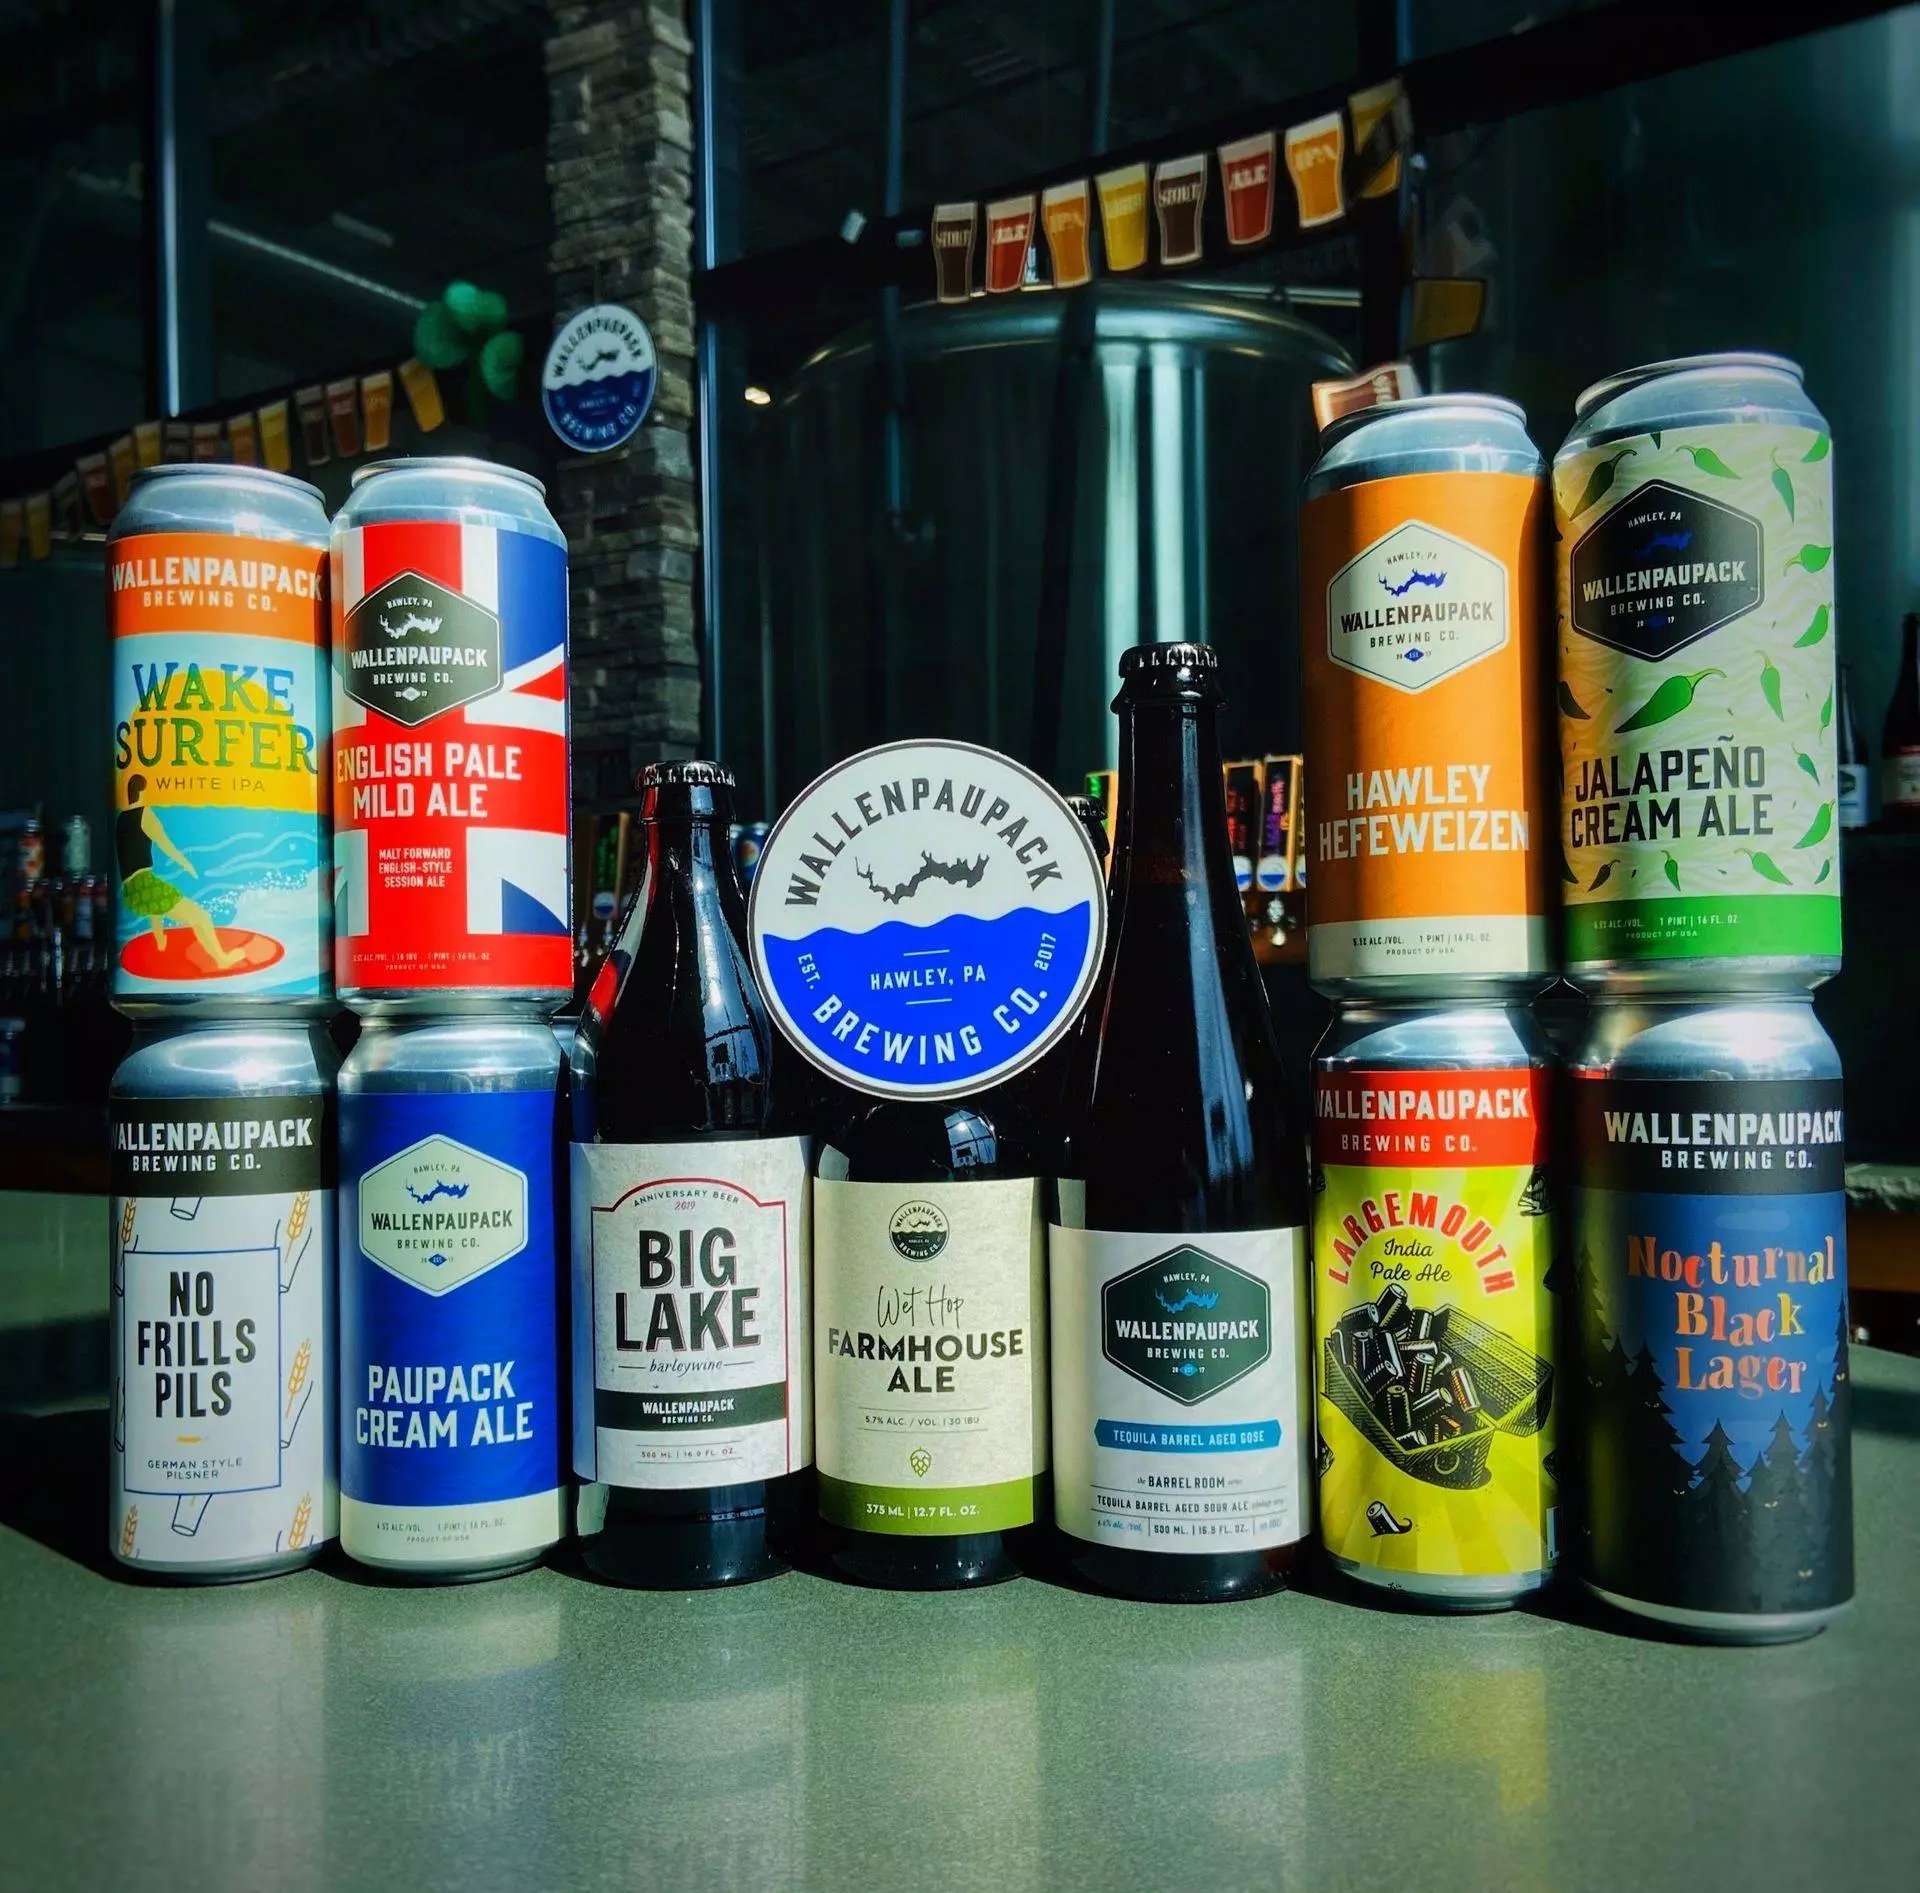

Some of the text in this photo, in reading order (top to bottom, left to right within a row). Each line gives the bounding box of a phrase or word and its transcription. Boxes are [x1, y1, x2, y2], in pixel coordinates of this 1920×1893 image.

[1229, 164, 1268, 192] ALE
[1628, 511, 1681, 528] HAWLEY, PA
[1387, 552, 1437, 565] HAWLEY, PA
[112, 557, 322, 602] WALLENPAUPACK
[1582, 561, 1746, 602] WALLENPAUPACK
[143, 590, 277, 612] BREWING CO.
[1610, 593, 1705, 616] BREWING CO.
[1341, 602, 1493, 634] WALLENPAUPACK
[1370, 631, 1460, 648] BREWING CO.
[351, 646, 488, 669] WALLENPAUPACK
[132, 662, 295, 717] WAKE
[373, 673, 453, 685] BREWING CO.
[116, 719, 319, 775] SURFER
[337, 743, 522, 782] ENGLISH PALE
[1574, 735, 1765, 802] JALAPEÑO
[156, 776, 266, 794] WHITE IPA
[1347, 765, 1491, 812] HAWLEY
[353, 782, 488, 819] MILD ALE
[1570, 794, 1774, 849] CREAM ALE
[784, 778, 1062, 906] WALLENPAUPACK
[1319, 811, 1529, 862] HEFEWEIZEN
[380, 848, 452, 860] MALT FORWARD
[379, 861, 452, 874] ENGLISH-STYLE
[384, 876, 445, 888] SESSION ALE
[1668, 917, 1687, 926] PINT
[1034, 932, 1057, 971] 2017
[798, 952, 820, 990] EST.
[870, 964, 986, 990] HAWLEY, PA
[812, 986, 1048, 1065] BREWING CO.
[1604, 1110, 1843, 1147] WALLENPAUPACK
[1342, 1133, 1478, 1152] BREWING CO.
[132, 1154, 262, 1172] BREWING CO.
[414, 1164, 460, 1174] HAWLEY, PA
[1662, 1151, 1812, 1169] BREWING CO.
[634, 1190, 740, 1207] ANNIVERSARY BEER
[674, 1200, 696, 1210] 2019
[371, 1210, 512, 1230] WALLENPAUPACK
[397, 1238, 480, 1248] BREWING CO.
[1328, 1191, 1515, 1294] LARGEMOUTH
[1384, 1238, 1434, 1259] India
[639, 1226, 737, 1290] BIG
[1627, 1235, 1836, 1288] Nocturnal
[1163, 1273, 1210, 1283] HAWLEY, PA
[1370, 1261, 1453, 1282] Pale Ale
[169, 1271, 215, 1317] NO
[877, 1284, 965, 1328] Wet Hop
[615, 1286, 761, 1353] LAKE
[1116, 1320, 1259, 1341] WALLENPAUPACK
[1676, 1292, 1806, 1348] Black
[138, 1318, 257, 1368] FRILLS
[829, 1328, 1024, 1362] FARMHOUSE
[1147, 1348, 1230, 1359] BREWING CO.
[650, 1356, 723, 1376] barleywine
[1675, 1346, 1807, 1400] Lager
[368, 1361, 516, 1404] PAUPACK
[887, 1366, 955, 1394] ALE
[156, 1372, 232, 1418] PILS
[642, 1398, 735, 1414] WALLENPAUPACK
[356, 1403, 534, 1449] CREAM ALE
[662, 1416, 698, 1424] BREWING
[866, 1416, 884, 1424] 5.7%
[949, 1418, 960, 1426] 30
[1113, 1430, 1264, 1446] TEQUILA BARREL AGED GOSE
[148, 1458, 242, 1469] GERMAN STYLE
[167, 1470, 220, 1480] PILSNER
[1148, 1476, 1192, 1489] BARREL
[1194, 1477, 1225, 1489] ROOM
[866, 1504, 980, 1517] 375 ML 12.7 FL. OZ.
[1097, 1495, 1132, 1509] TEQUILA
[1135, 1500, 1170, 1512] BARREL
[1176, 1502, 1200, 1512] AGED
[1204, 1502, 1228, 1512] SOUR
[1232, 1500, 1248, 1511] ALE
[1154, 1524, 1170, 1534] 500
[1174, 1524, 1188, 1534] ML.
[1220, 1524, 1232, 1534] FL.
[1236, 1524, 1248, 1533] OZ.
